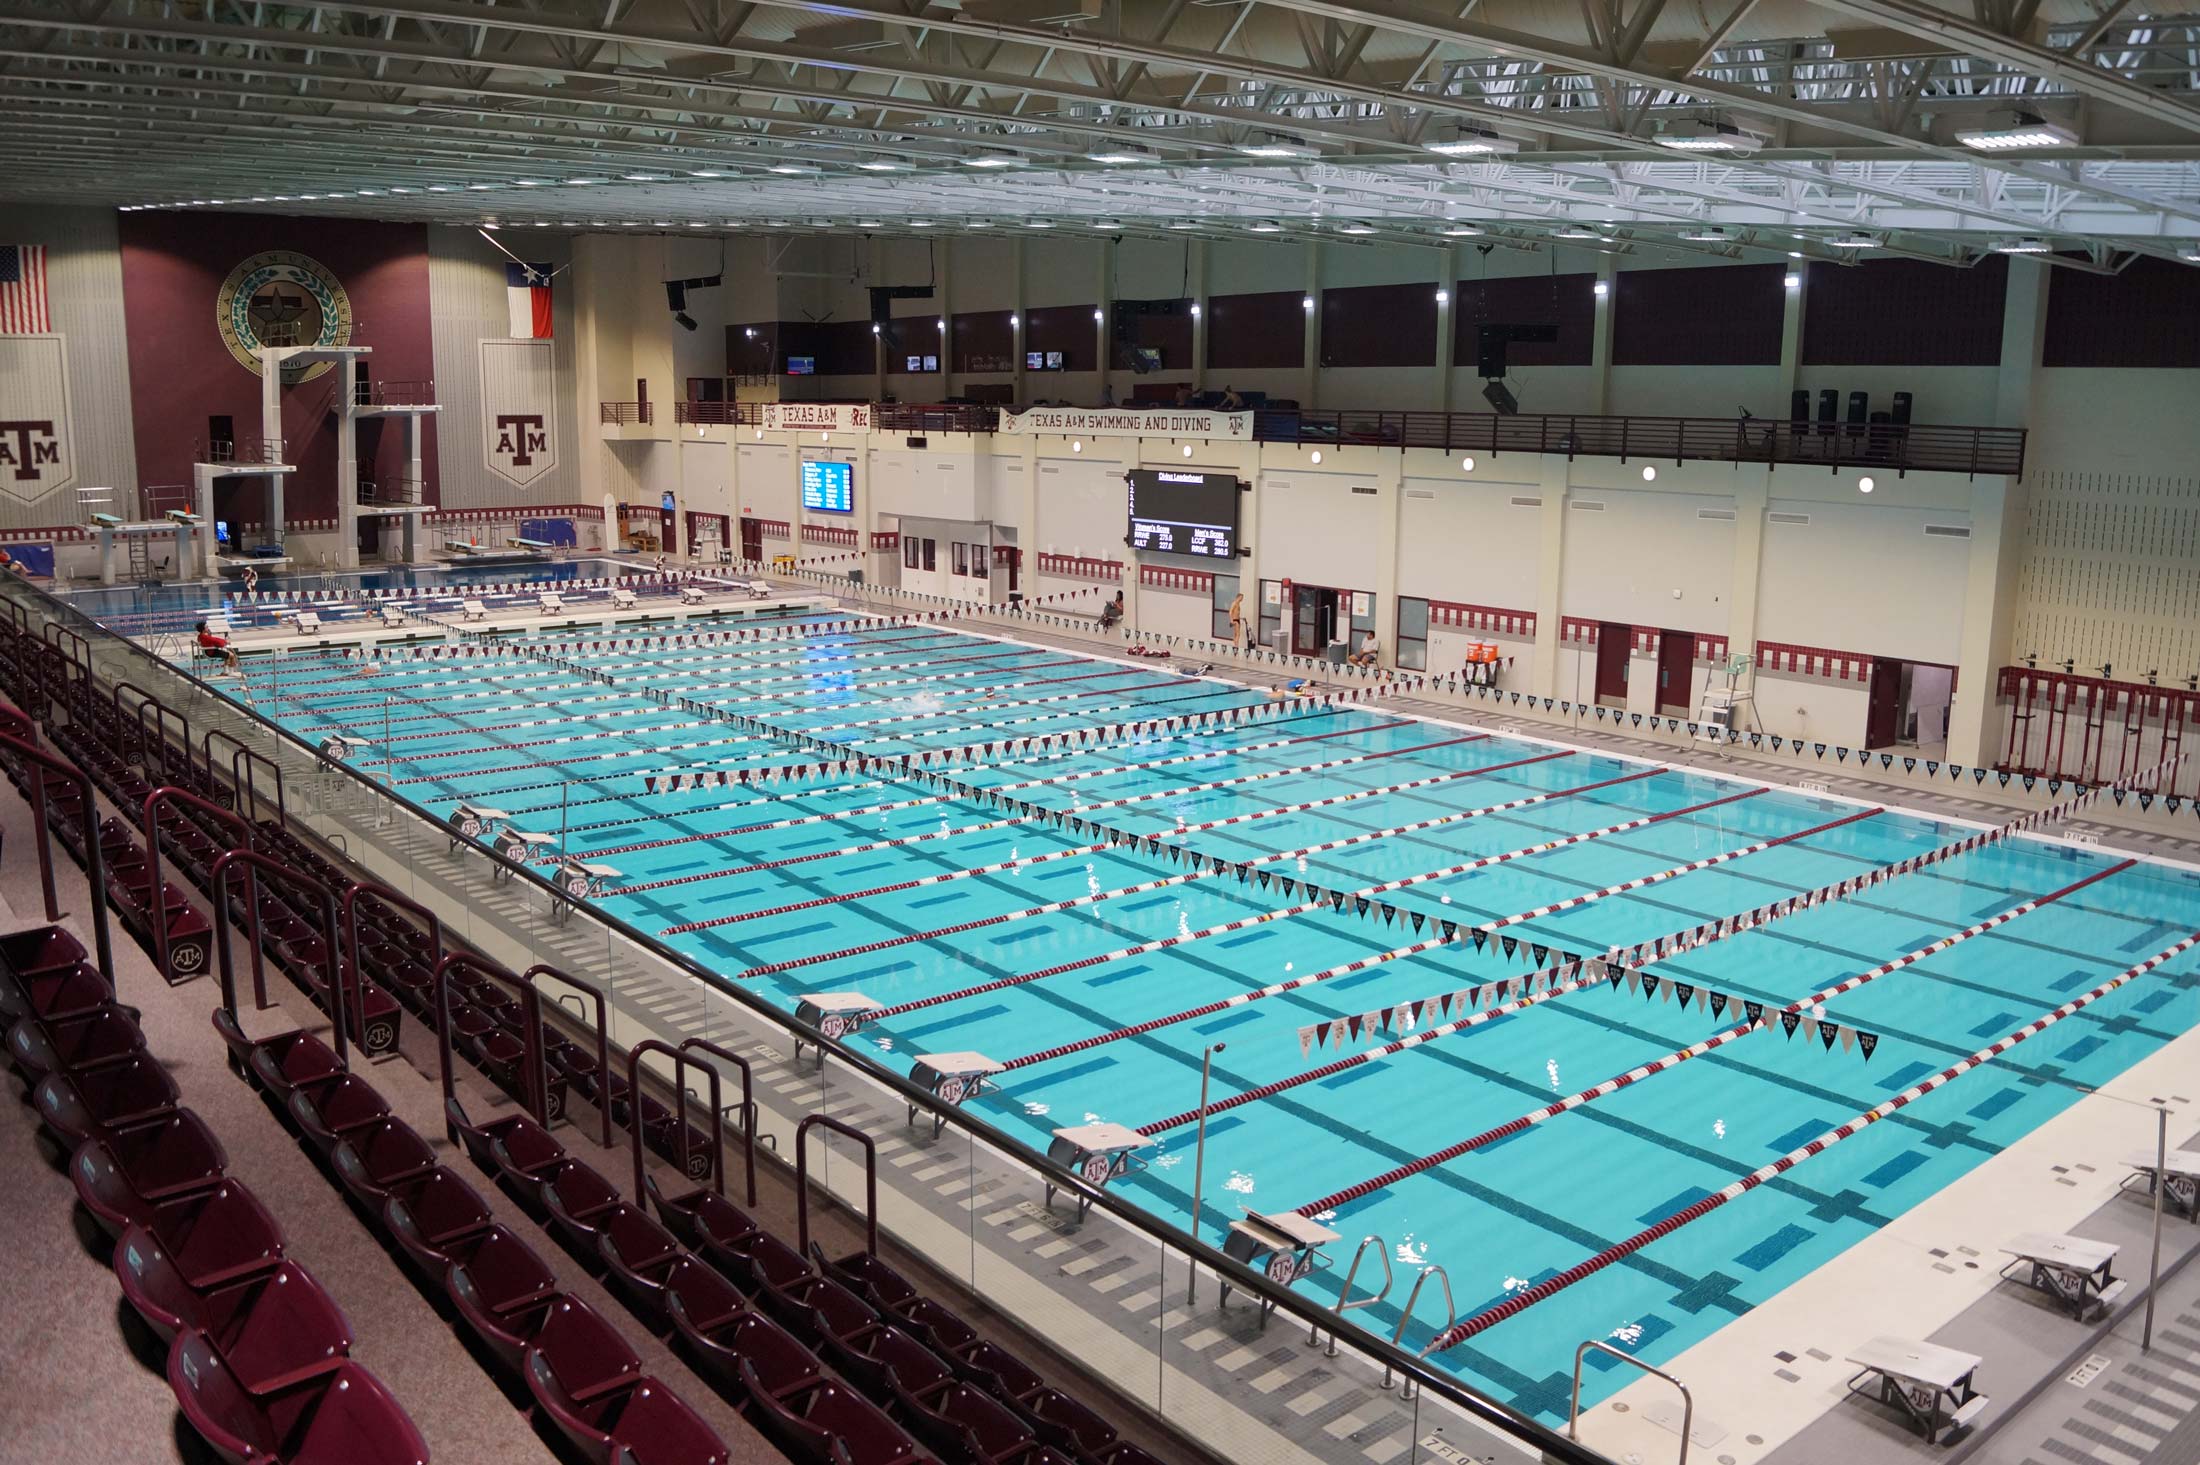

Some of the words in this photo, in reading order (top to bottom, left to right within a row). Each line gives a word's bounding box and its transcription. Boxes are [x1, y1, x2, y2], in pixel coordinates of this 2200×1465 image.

[782, 407, 814, 422] TEXAS
[817, 407, 838, 423] A&M
[1030, 414, 1062, 428] TEXAS
[1064, 414, 1085, 429] A&M
[1088, 415, 1141, 431] SWIMMING
[1144, 416, 1168, 431] AND
[1171, 416, 1212, 432] DIVING
[496, 415, 547, 466] ATM
[824, 1018, 843, 1037] ATM
[852, 1021, 858, 1031] 4
[942, 1080, 962, 1102] ATM
[1087, 1157, 1108, 1182] ATM
[1272, 1256, 1293, 1282] ATM
[2036, 1274, 2044, 1287] 2
[1909, 1386, 1933, 1409] ATM
[1425, 1438, 1440, 1447] 7
[1438, 1446, 1458, 1458] FT
